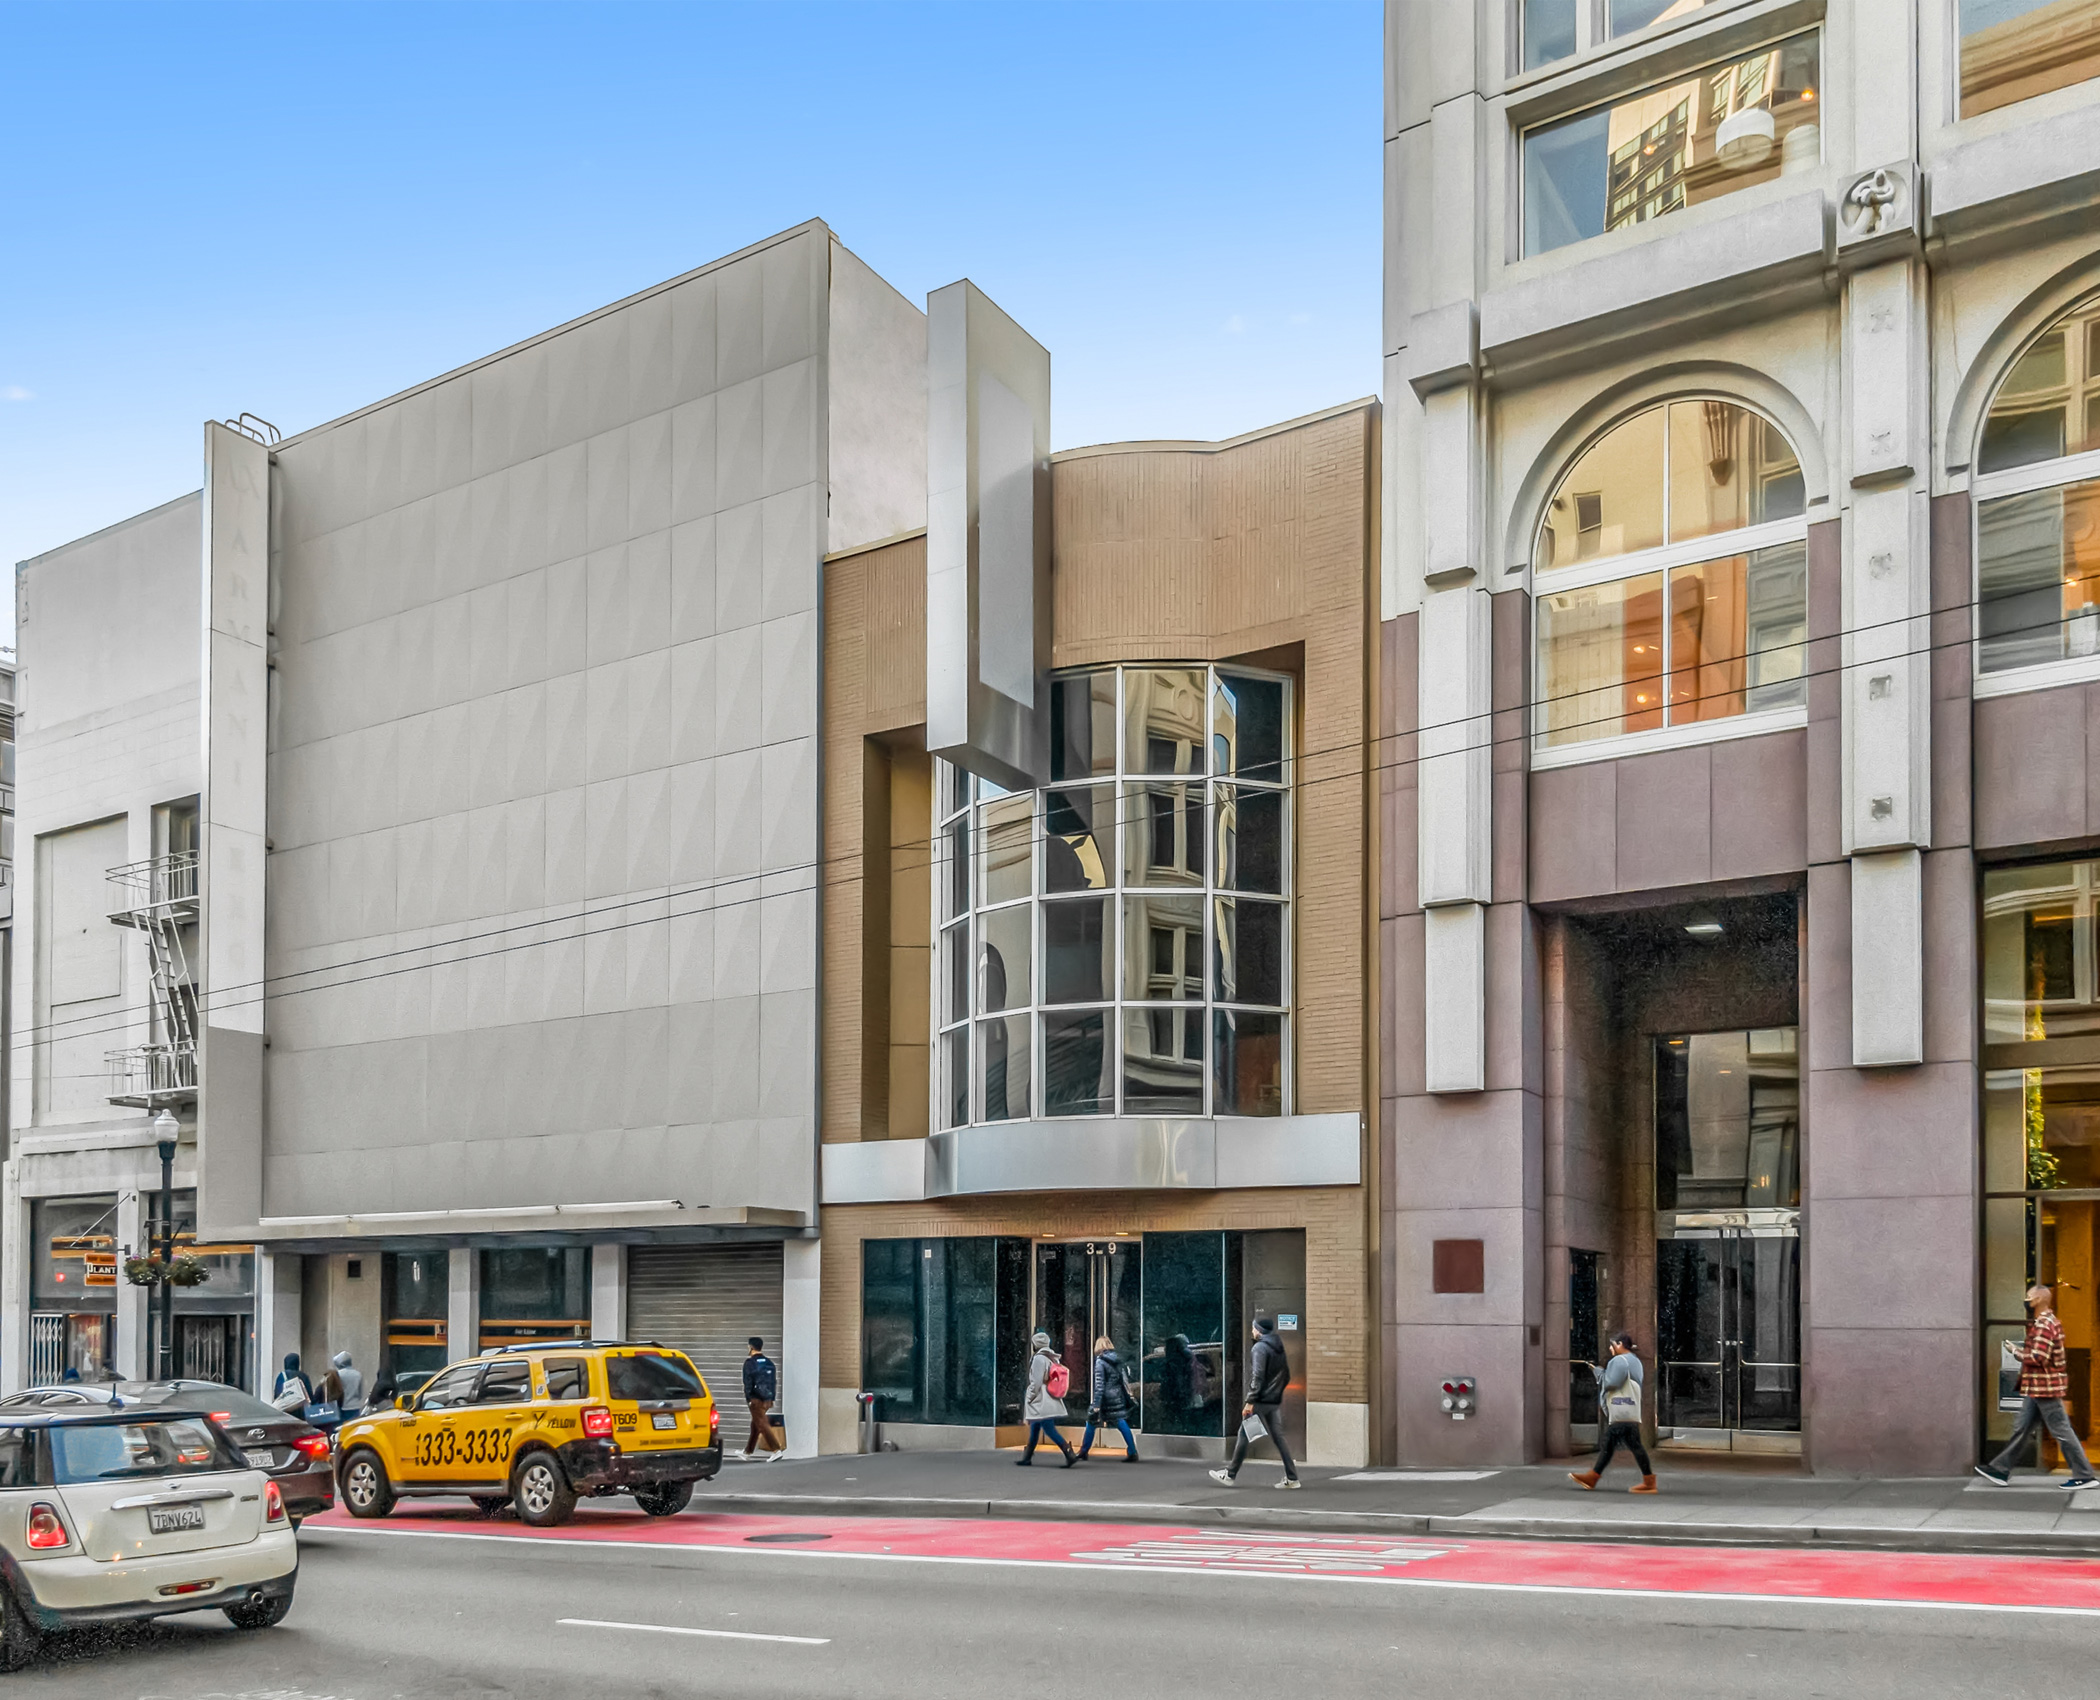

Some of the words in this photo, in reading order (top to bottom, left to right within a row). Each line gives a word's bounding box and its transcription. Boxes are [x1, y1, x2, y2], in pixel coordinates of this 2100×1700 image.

[1086, 1242, 1095, 1255] 3
[1108, 1242, 1117, 1255] 9
[86, 1262, 117, 1278] PLANT
[547, 1418, 576, 1429] YELLOW
[612, 1413, 638, 1425] T609
[421, 1427, 513, 1466] 333-3333
[154, 1511, 202, 1529] 7BNV624
